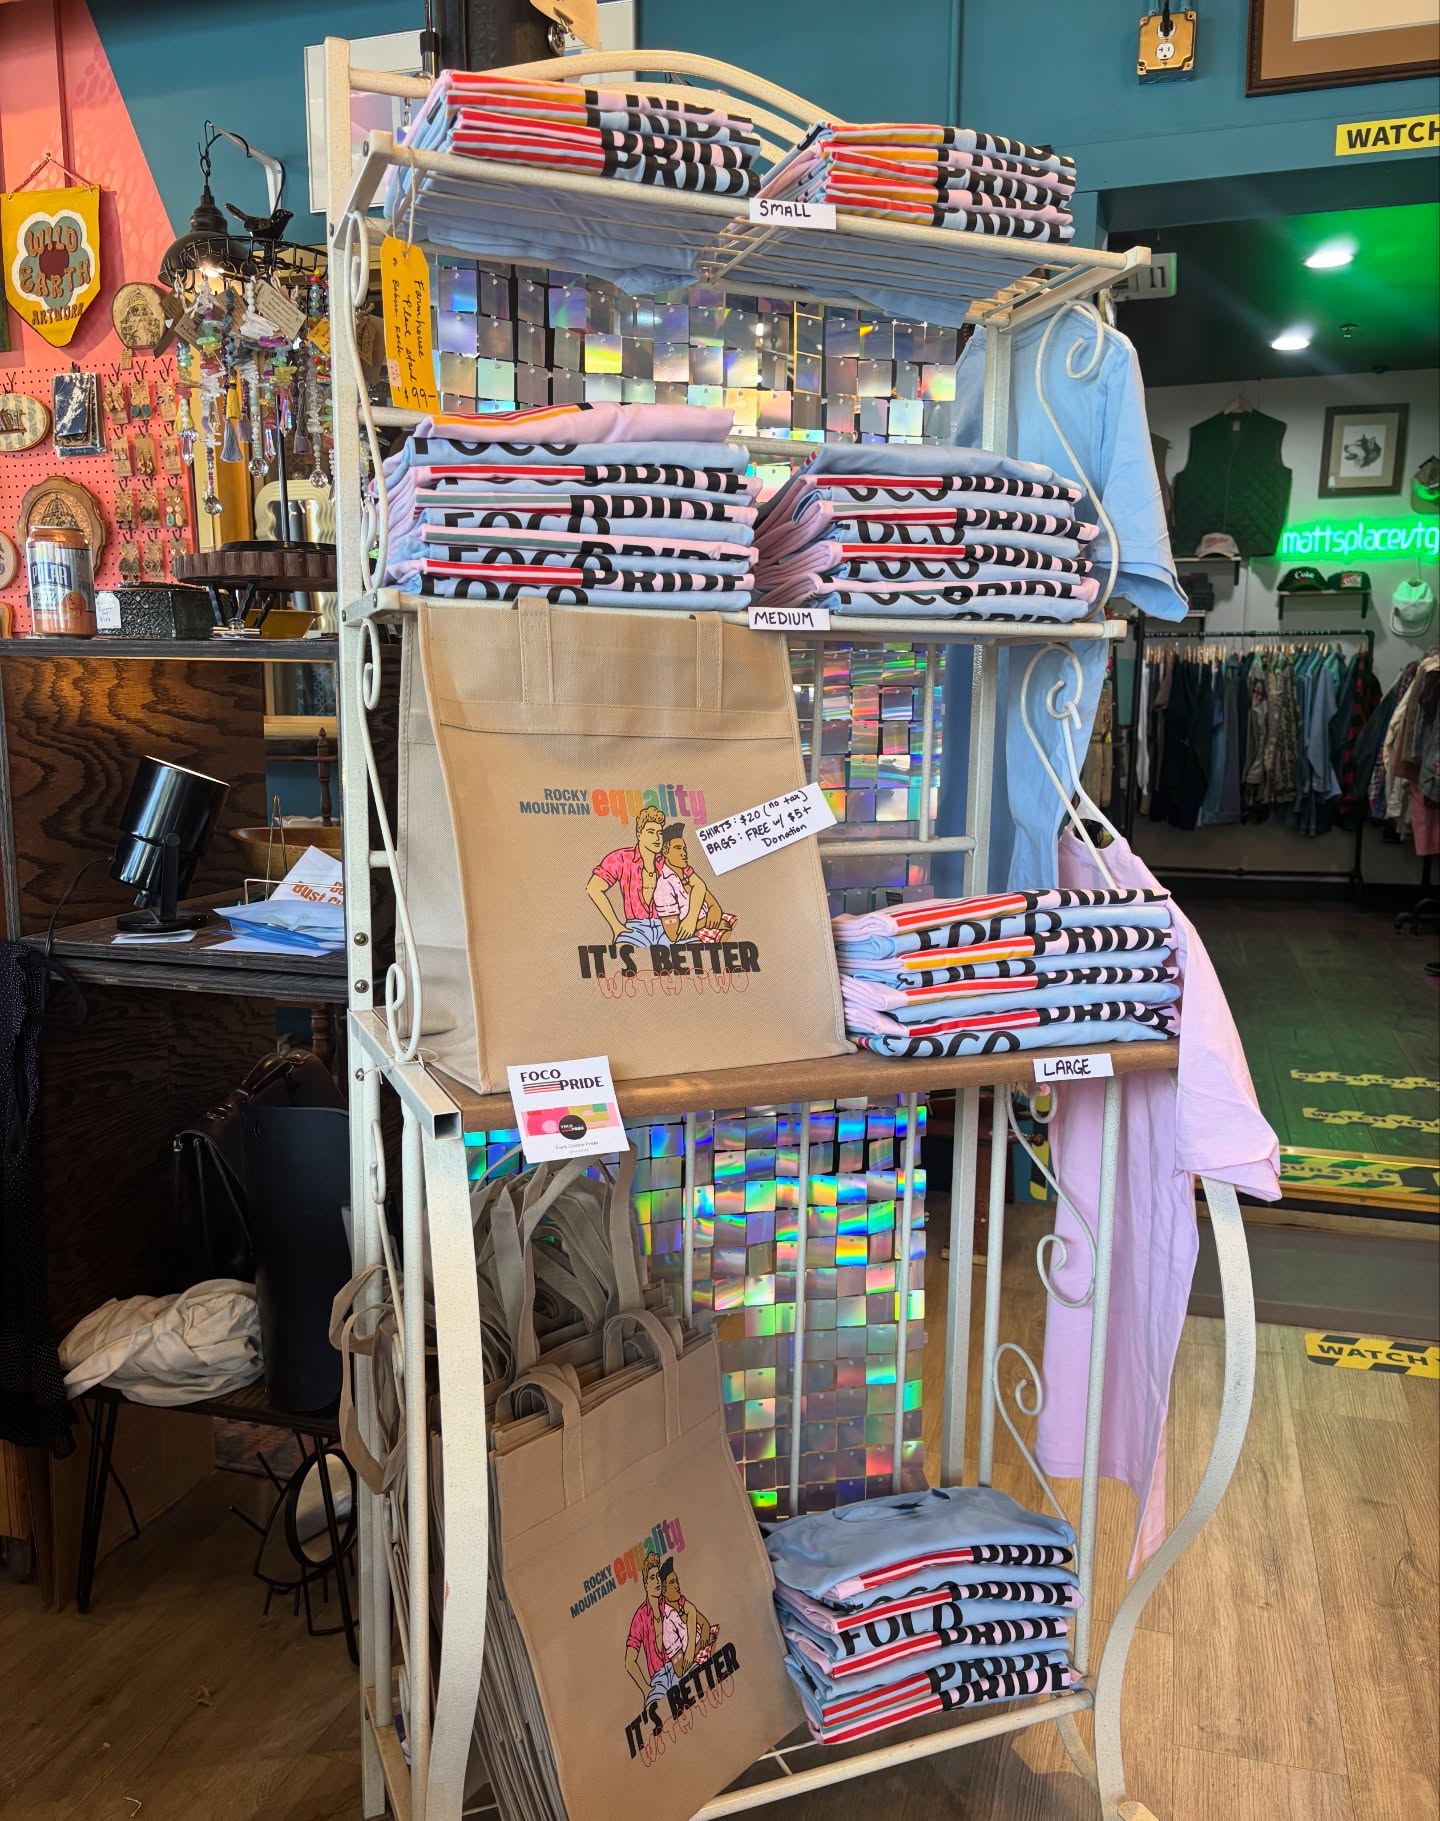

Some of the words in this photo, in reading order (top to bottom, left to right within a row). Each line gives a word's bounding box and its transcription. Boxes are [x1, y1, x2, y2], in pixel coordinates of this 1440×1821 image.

[1347, 121, 1440, 149] WATCH
[26, 226, 79, 257] WILD
[19, 259, 92, 299] EARTH
[32, 302, 84, 326] ARTWORK
[754, 611, 815, 627] MEDIUM
[519, 801, 591, 815] MOUNTAIN
[544, 788, 588, 801] ROCKY
[591, 783, 708, 826] equality
[740, 810, 761, 826] $20
[745, 822, 771, 841] FREE
[773, 814, 785, 829] w/
[761, 823, 808, 848] Donation
[578, 944, 638, 979] IT'S
[650, 941, 762, 977] BETTER
[520, 1069, 561, 1083] FOCO
[1043, 1058, 1092, 1076] LARGE
[560, 1076, 605, 1091] PRIDE
[1311, 1112, 1387, 1124] WATCH
[1317, 1344, 1429, 1366] WATCH
[613, 1517, 687, 1586] equality
[583, 1564, 613, 1593] ROCKY
[569, 1578, 617, 1618] MOUNTAIN
[624, 1701, 664, 1760] IT'S
[666, 1641, 741, 1721] BETTER
[939, 1663, 1070, 1711] PRIDE
